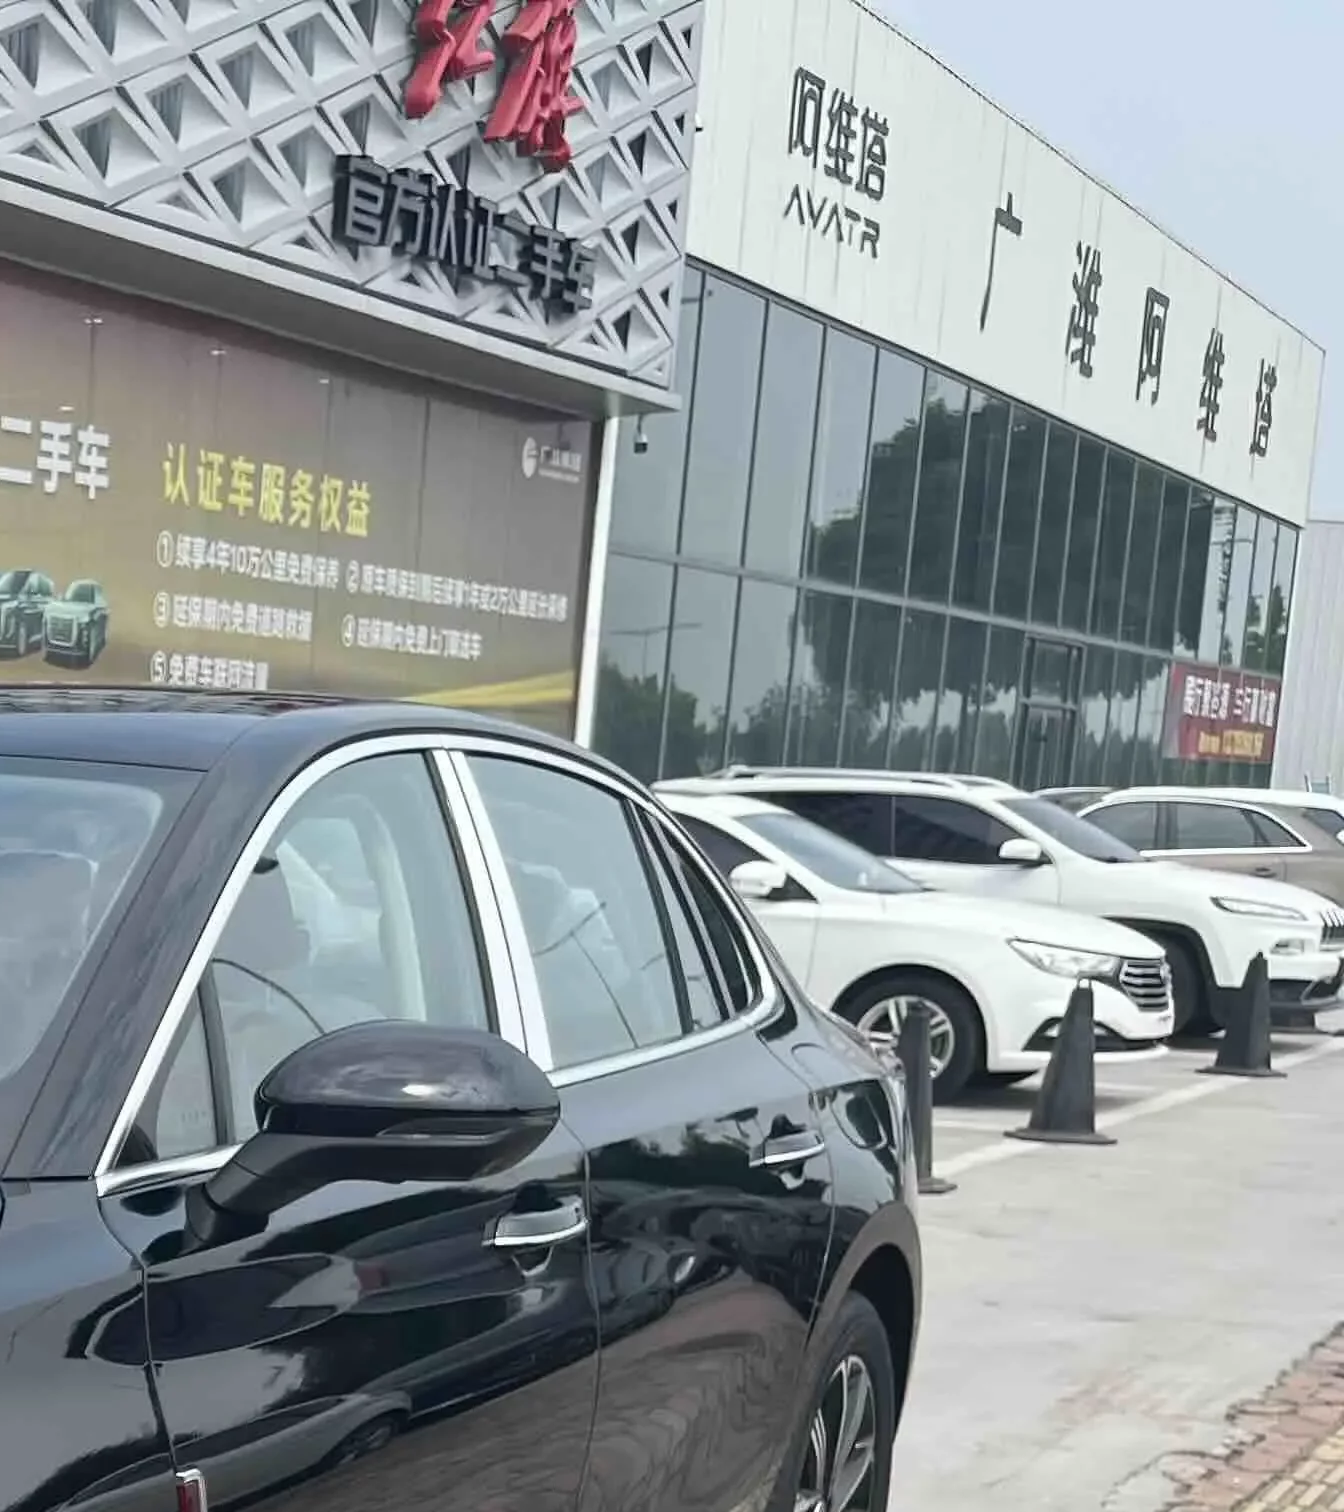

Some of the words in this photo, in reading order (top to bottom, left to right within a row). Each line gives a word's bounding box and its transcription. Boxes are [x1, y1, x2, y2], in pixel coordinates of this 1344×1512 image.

[788, 66, 889, 201] 阿维塔
[331, 155, 597, 314] 官方认证二手车
[783, 184, 881, 258] AVATR
[162, 442, 372, 538] 认证车服务权益
